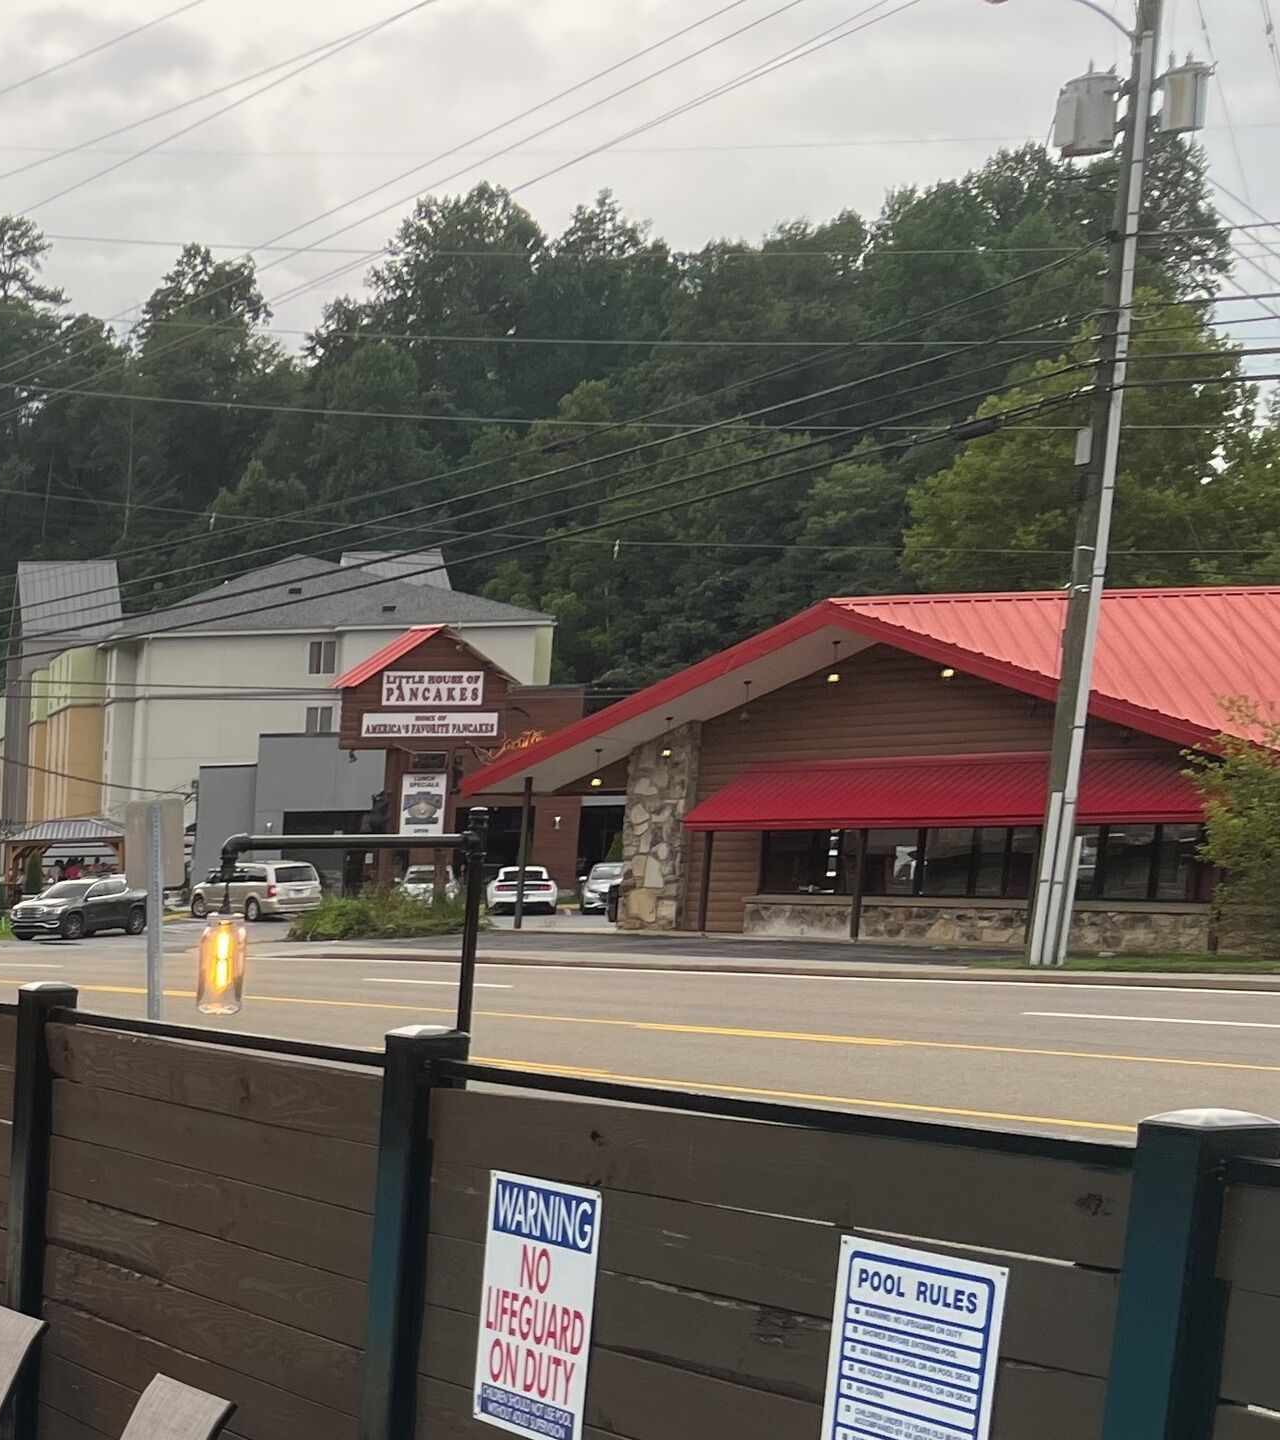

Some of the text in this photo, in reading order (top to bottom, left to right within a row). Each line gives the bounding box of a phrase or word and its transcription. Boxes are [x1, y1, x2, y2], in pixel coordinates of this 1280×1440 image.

[385, 687, 479, 701] PANCAKES
[386, 675, 481, 685] LITTLE HOUSE OF
[364, 723, 495, 735] AMERICA'S FAVORITE PANCAKES
[495, 1182, 593, 1250] WARNING
[520, 1243, 551, 1295] NO
[858, 1267, 977, 1314] POOL RULES
[485, 1285, 585, 1358] LIFEGUARD
[893, 1316, 901, 1324] NO
[902, 1318, 934, 1332] LIFEGUARD
[936, 1326, 944, 1334] ON
[945, 1328, 962, 1339] DUTY
[862, 1328, 956, 1358] SHOWER BEFORE ENTERING POOL
[489, 1336, 574, 1407] ON DUTY
[859, 1347, 867, 1355] NO
[870, 1350, 892, 1362] ANIMALS
[901, 1358, 916, 1368] POOL
[918, 1363, 925, 1371] OR
[927, 1365, 935, 1373] ON
[938, 1368, 953, 1378] POOL
[954, 1372, 971, 1382] DECK
[856, 1385, 883, 1398] NO DIVING
[858, 1366, 865, 1374] NO
[867, 1369, 882, 1379] FOOD
[884, 1373, 891, 1381] OR
[893, 1376, 909, 1386] DRINK
[918, 1382, 934, 1393] POOL
[935, 1387, 943, 1395] OR
[945, 1390, 953, 1398] ON
[955, 1392, 971, 1403] DECK
[482, 1384, 507, 1404] CHILDREN
[507, 1393, 530, 1412] SHOULD
[531, 1401, 543, 1417] NOT
[544, 1406, 556, 1421] USE
[555, 1409, 572, 1427] POOL
[488, 1400, 565, 1439] WITHOUT ADULT SUPERVISION
[854, 1407, 881, 1421] CHILDREN
[883, 1416, 902, 1427] UNDER
[911, 1424, 930, 1436] YEARS
[932, 1430, 943, 1439] OLD
[854, 1416, 893, 1433] ACCOMPANIED
[894, 1428, 901, 1436] BY
